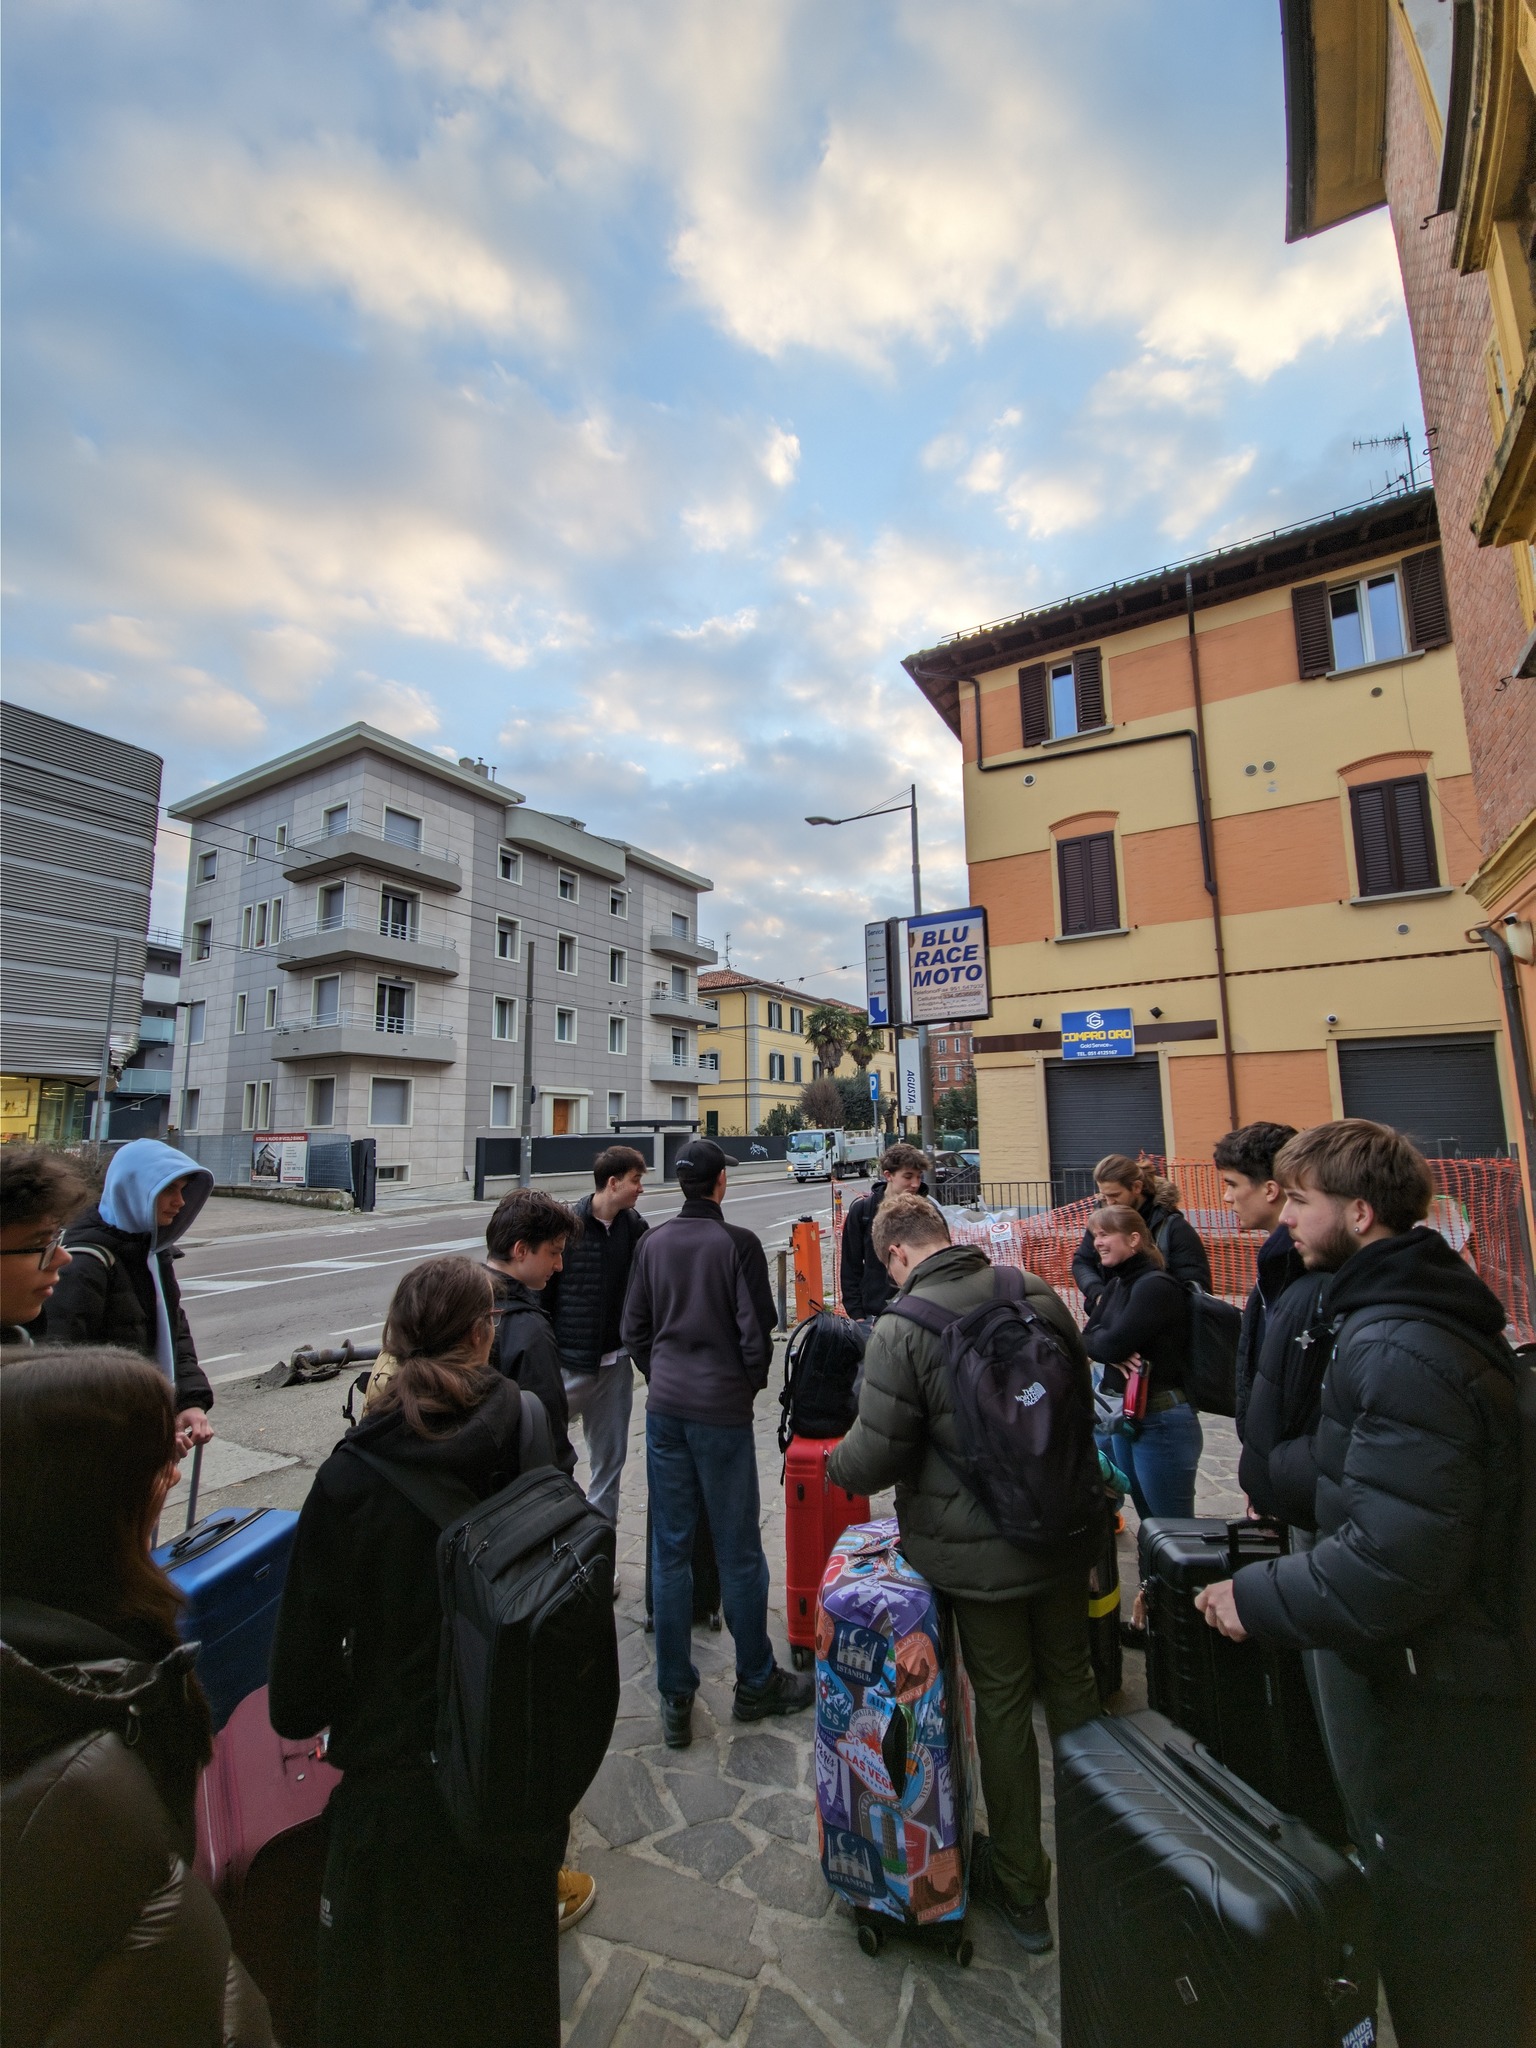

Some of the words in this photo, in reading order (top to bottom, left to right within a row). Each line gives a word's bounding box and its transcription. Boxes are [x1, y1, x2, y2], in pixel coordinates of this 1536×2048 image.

[867, 929, 884, 937] Service
[921, 925, 969, 947] BLU
[914, 944, 979, 968] RACE
[913, 964, 983, 988] MOTO
[1062, 1030, 1106, 1042] COMPRO
[1108, 1029, 1132, 1040] ORO
[906, 1069, 916, 1104] AGUSTA
[1014, 1392, 1037, 1402] NORTH
[1022, 1386, 1035, 1396] THE
[1023, 1396, 1039, 1406] FACE
[902, 1634, 929, 1647] VALLEY
[836, 1663, 871, 1683] ISTANBUL
[869, 1696, 886, 1711] AIR
[846, 1750, 866, 1772] LAS
[829, 1873, 876, 1894] ISTANBUL
[1342, 2017, 1372, 2048] HANDS
